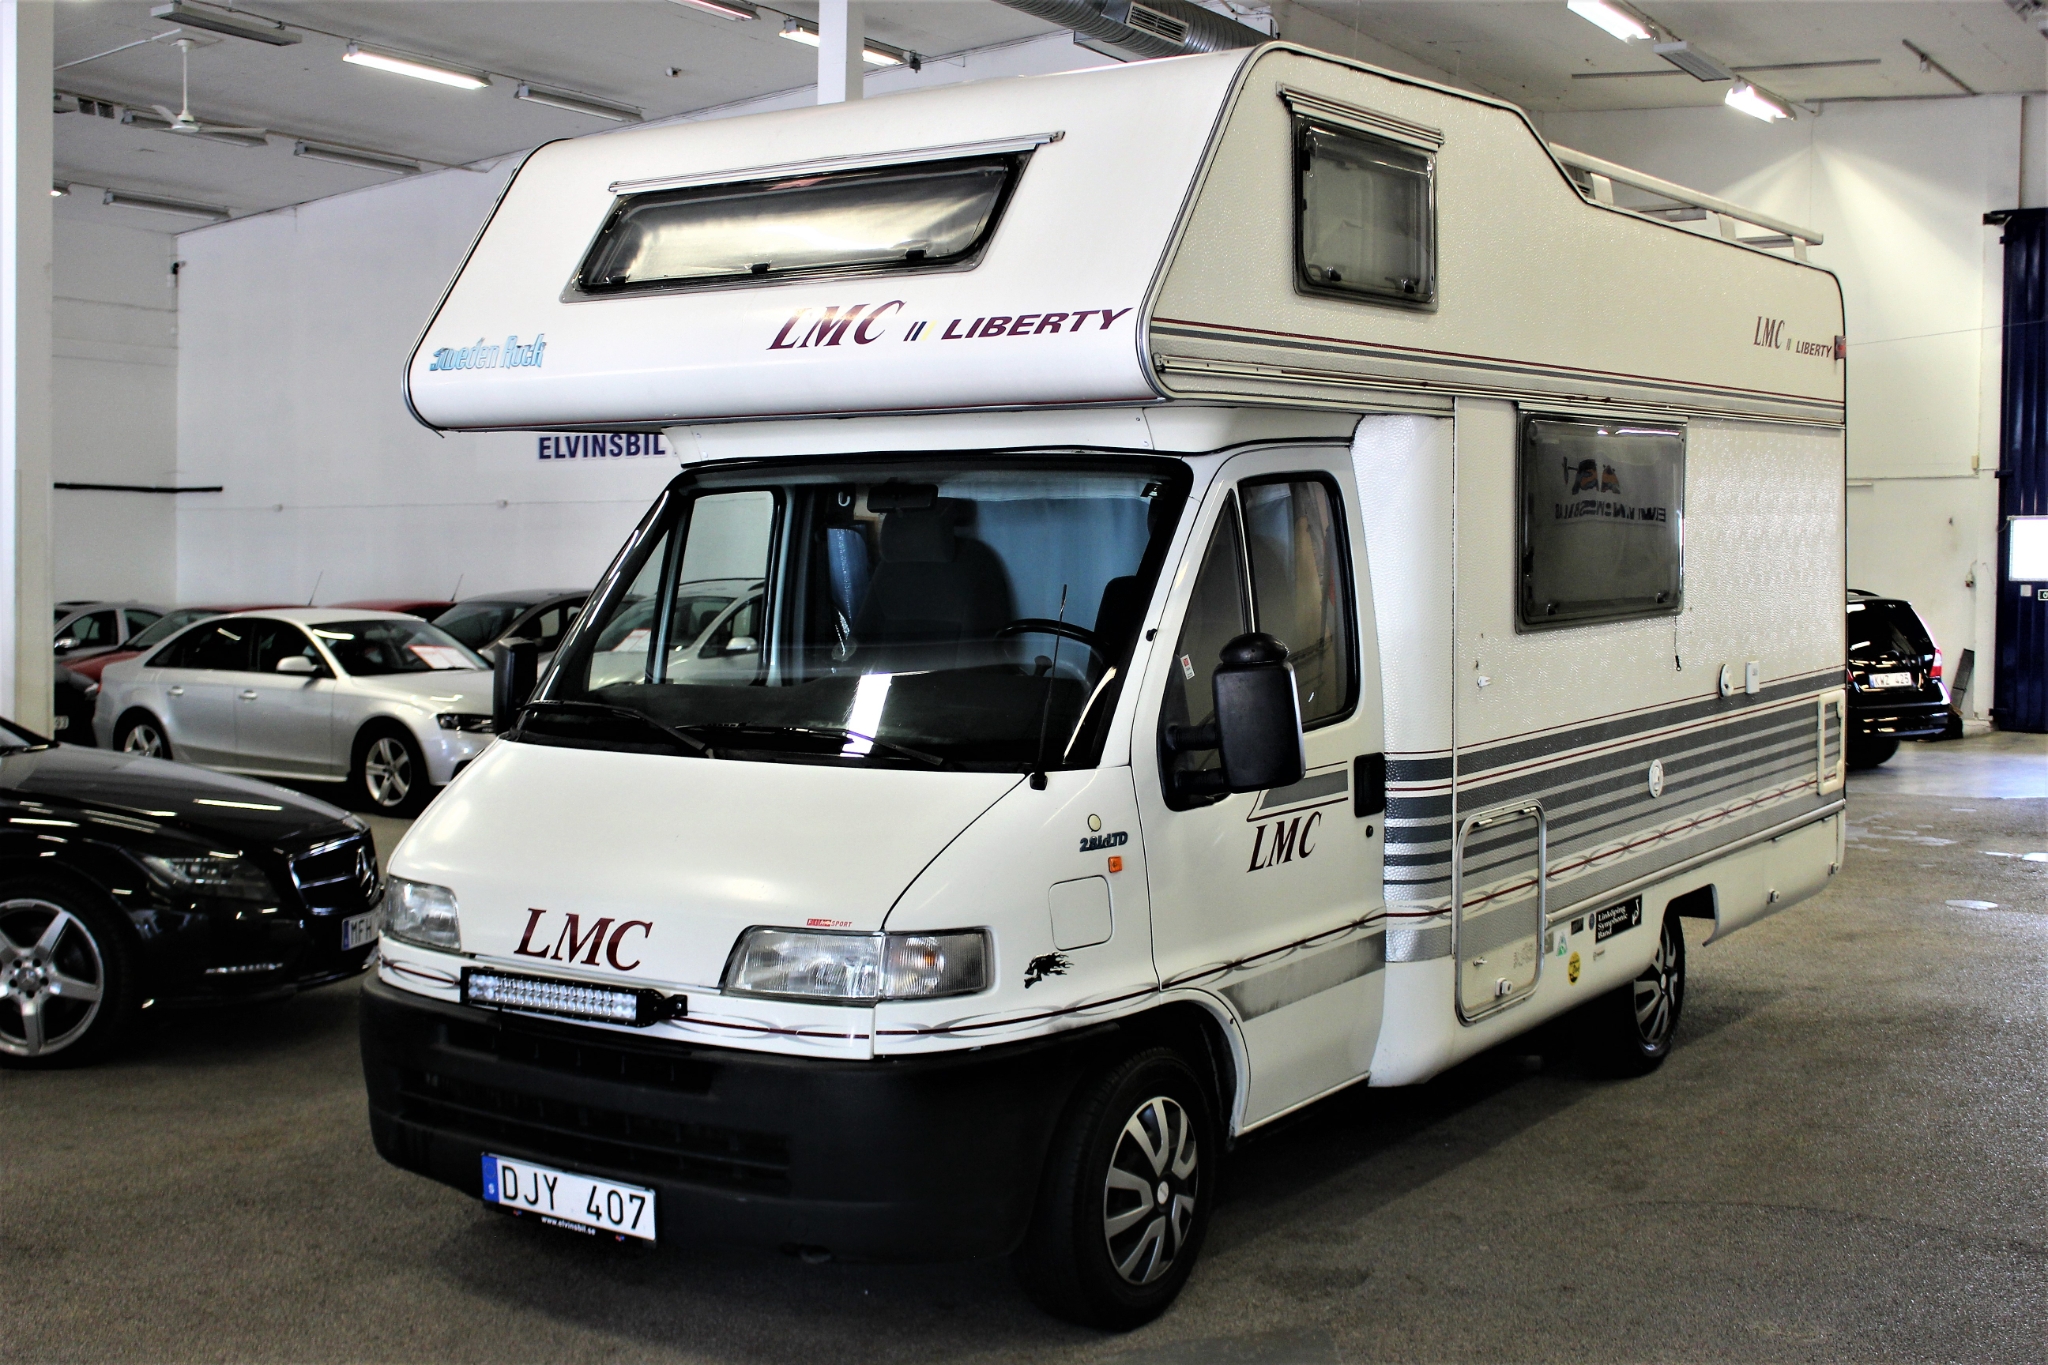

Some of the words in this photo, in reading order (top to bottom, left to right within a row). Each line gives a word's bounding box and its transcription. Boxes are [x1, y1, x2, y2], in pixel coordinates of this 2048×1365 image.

[766, 300, 907, 350] LMC
[941, 307, 1133, 340] LIBERTY
[1753, 316, 1785, 350] LMC
[1795, 340, 1832, 358] LIBERTY
[538, 432, 666, 460] ELVINSBIL
[1246, 811, 1322, 873] LMC
[513, 907, 653, 971] LMC
[501, 1165, 558, 1211] DJY
[586, 1184, 646, 1230] 407
